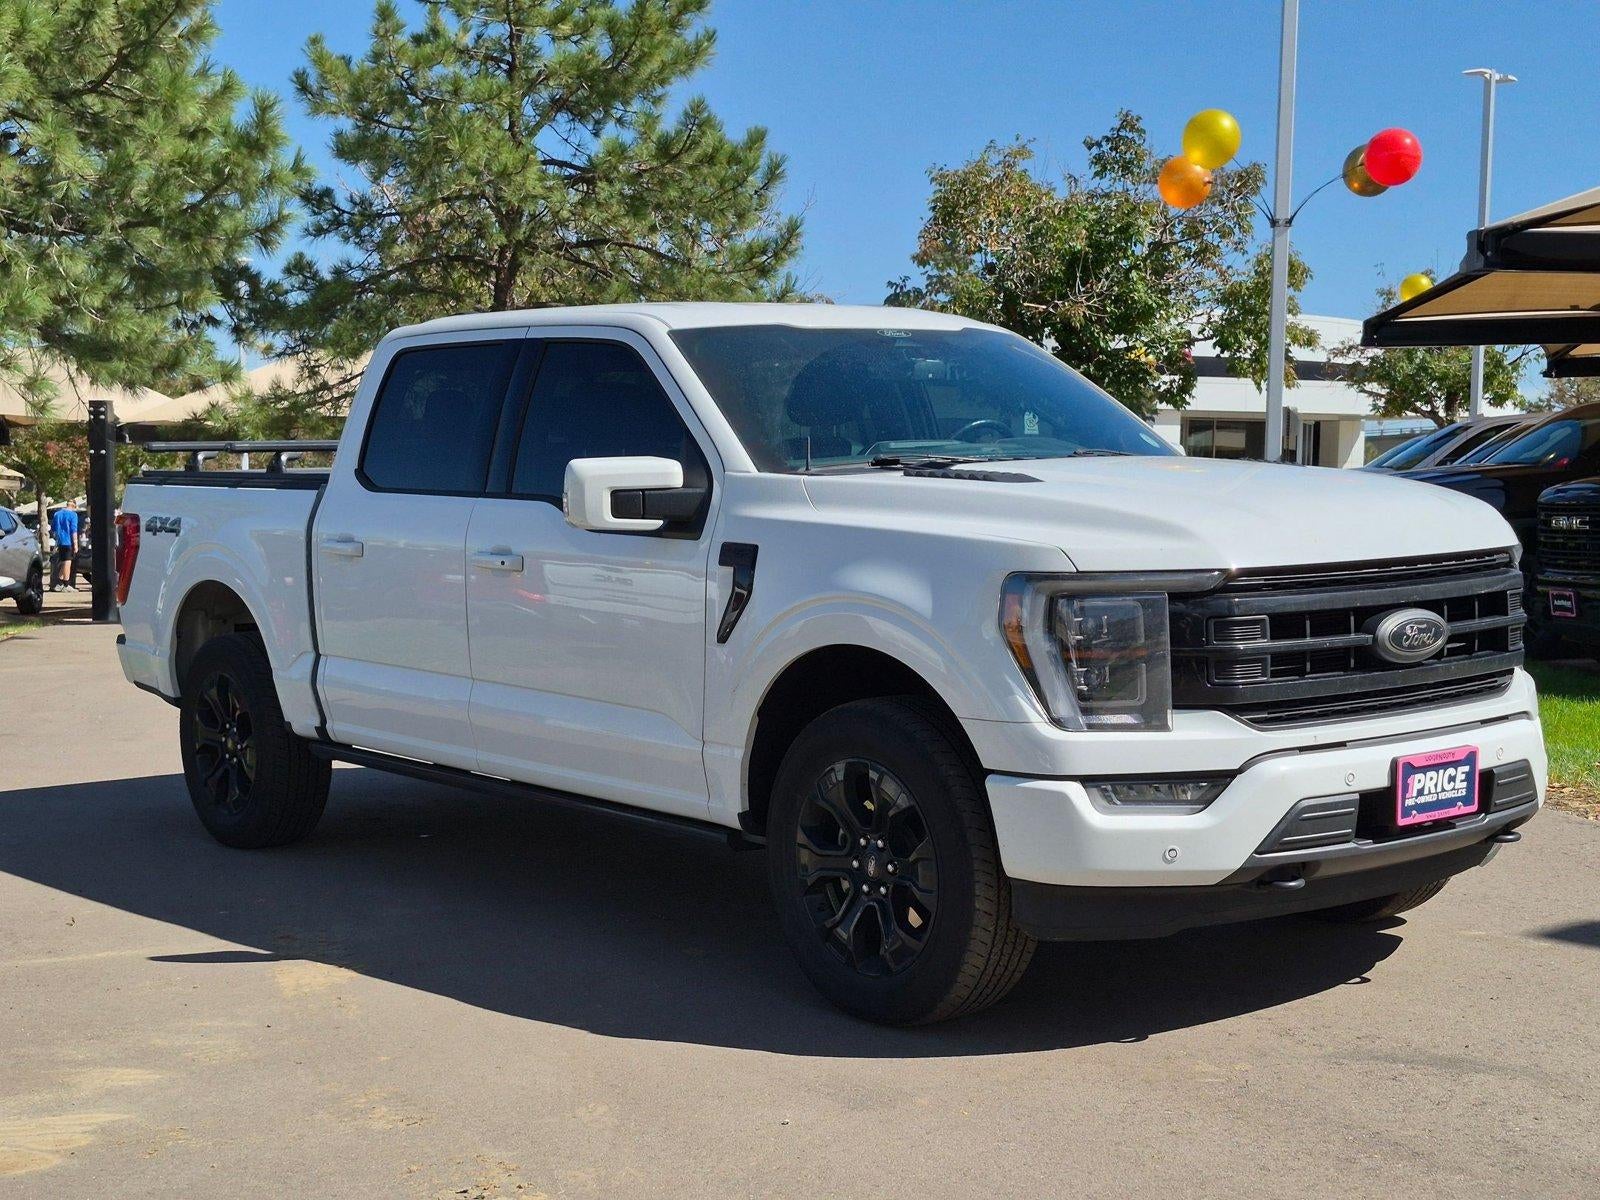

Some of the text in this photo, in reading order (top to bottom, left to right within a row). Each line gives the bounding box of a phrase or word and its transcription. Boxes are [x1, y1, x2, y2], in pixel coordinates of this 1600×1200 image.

[1551, 516, 1589, 530] GMC
[1402, 623, 1435, 647] Ford
[1405, 789, 1466, 807] PRE-OWNED VEHICLES
